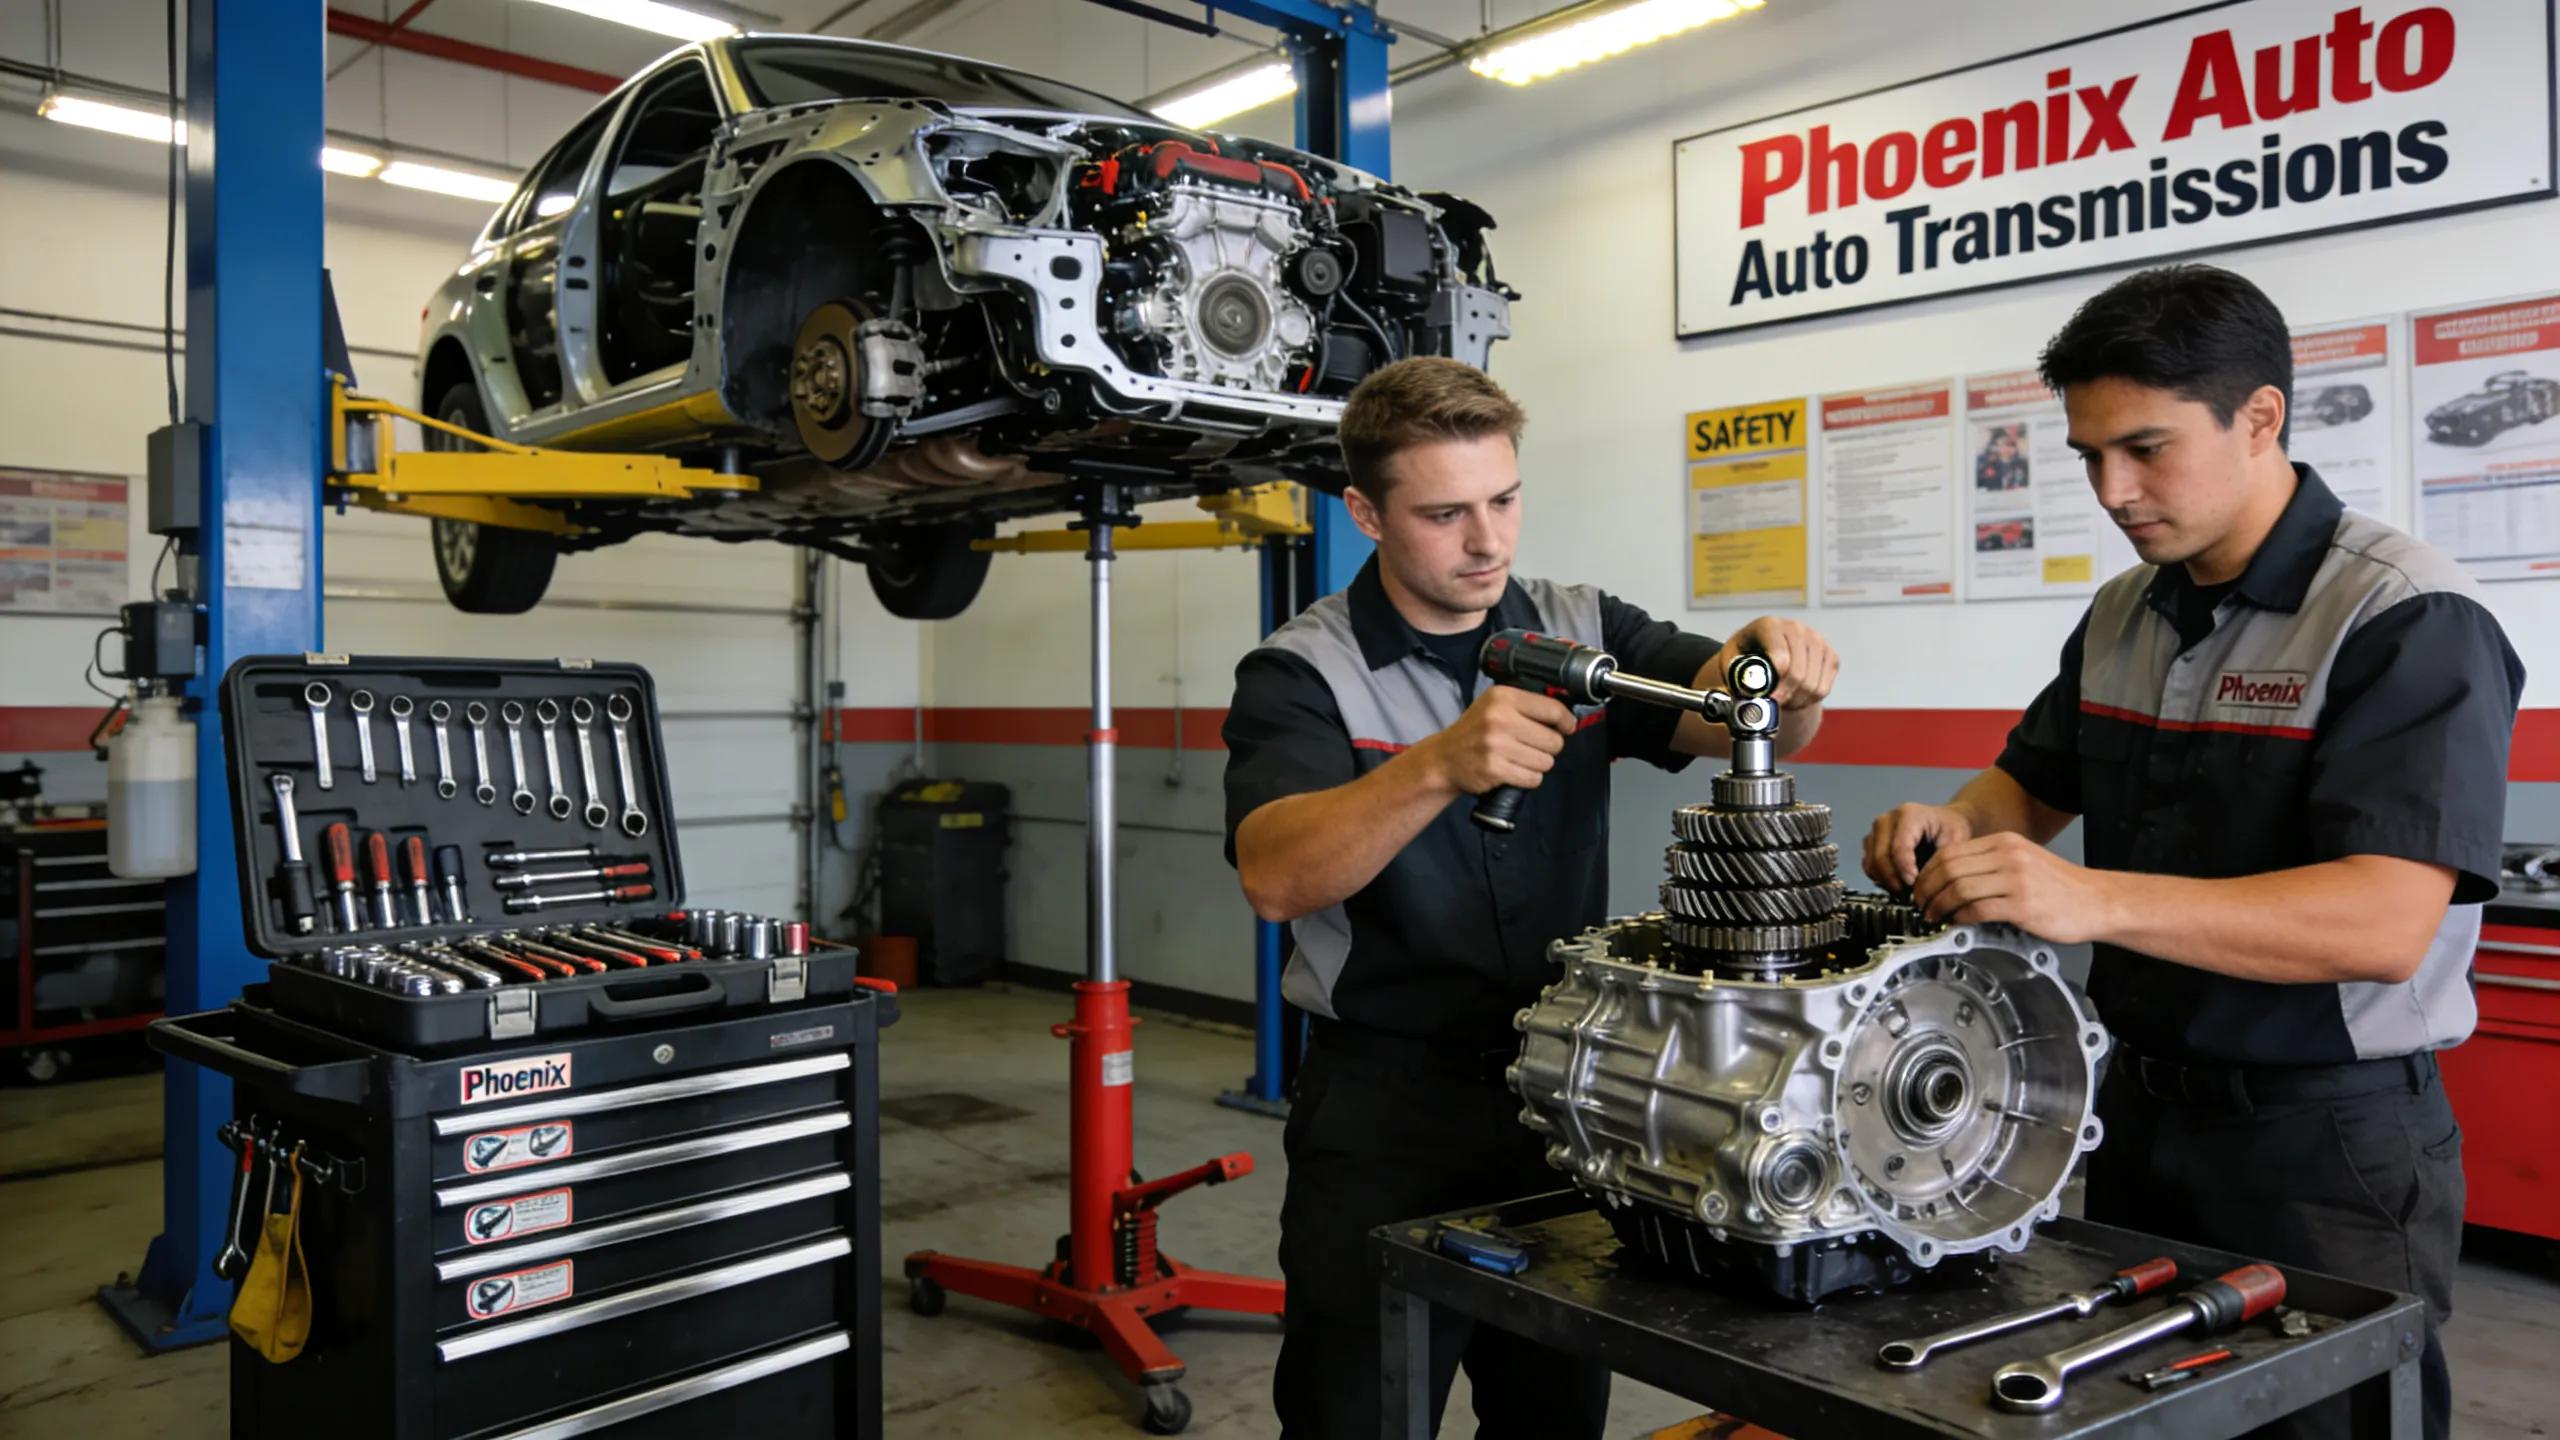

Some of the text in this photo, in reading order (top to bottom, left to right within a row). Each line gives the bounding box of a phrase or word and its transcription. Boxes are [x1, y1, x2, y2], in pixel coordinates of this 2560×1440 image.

[1738, 5, 2456, 230] Phoenix Auto
[1729, 119, 2450, 306] Auto Transmissions
[1695, 409, 1796, 452] SAFETY
[2217, 674, 2305, 704] Phoenix
[464, 1060, 567, 1101] Phoenix
